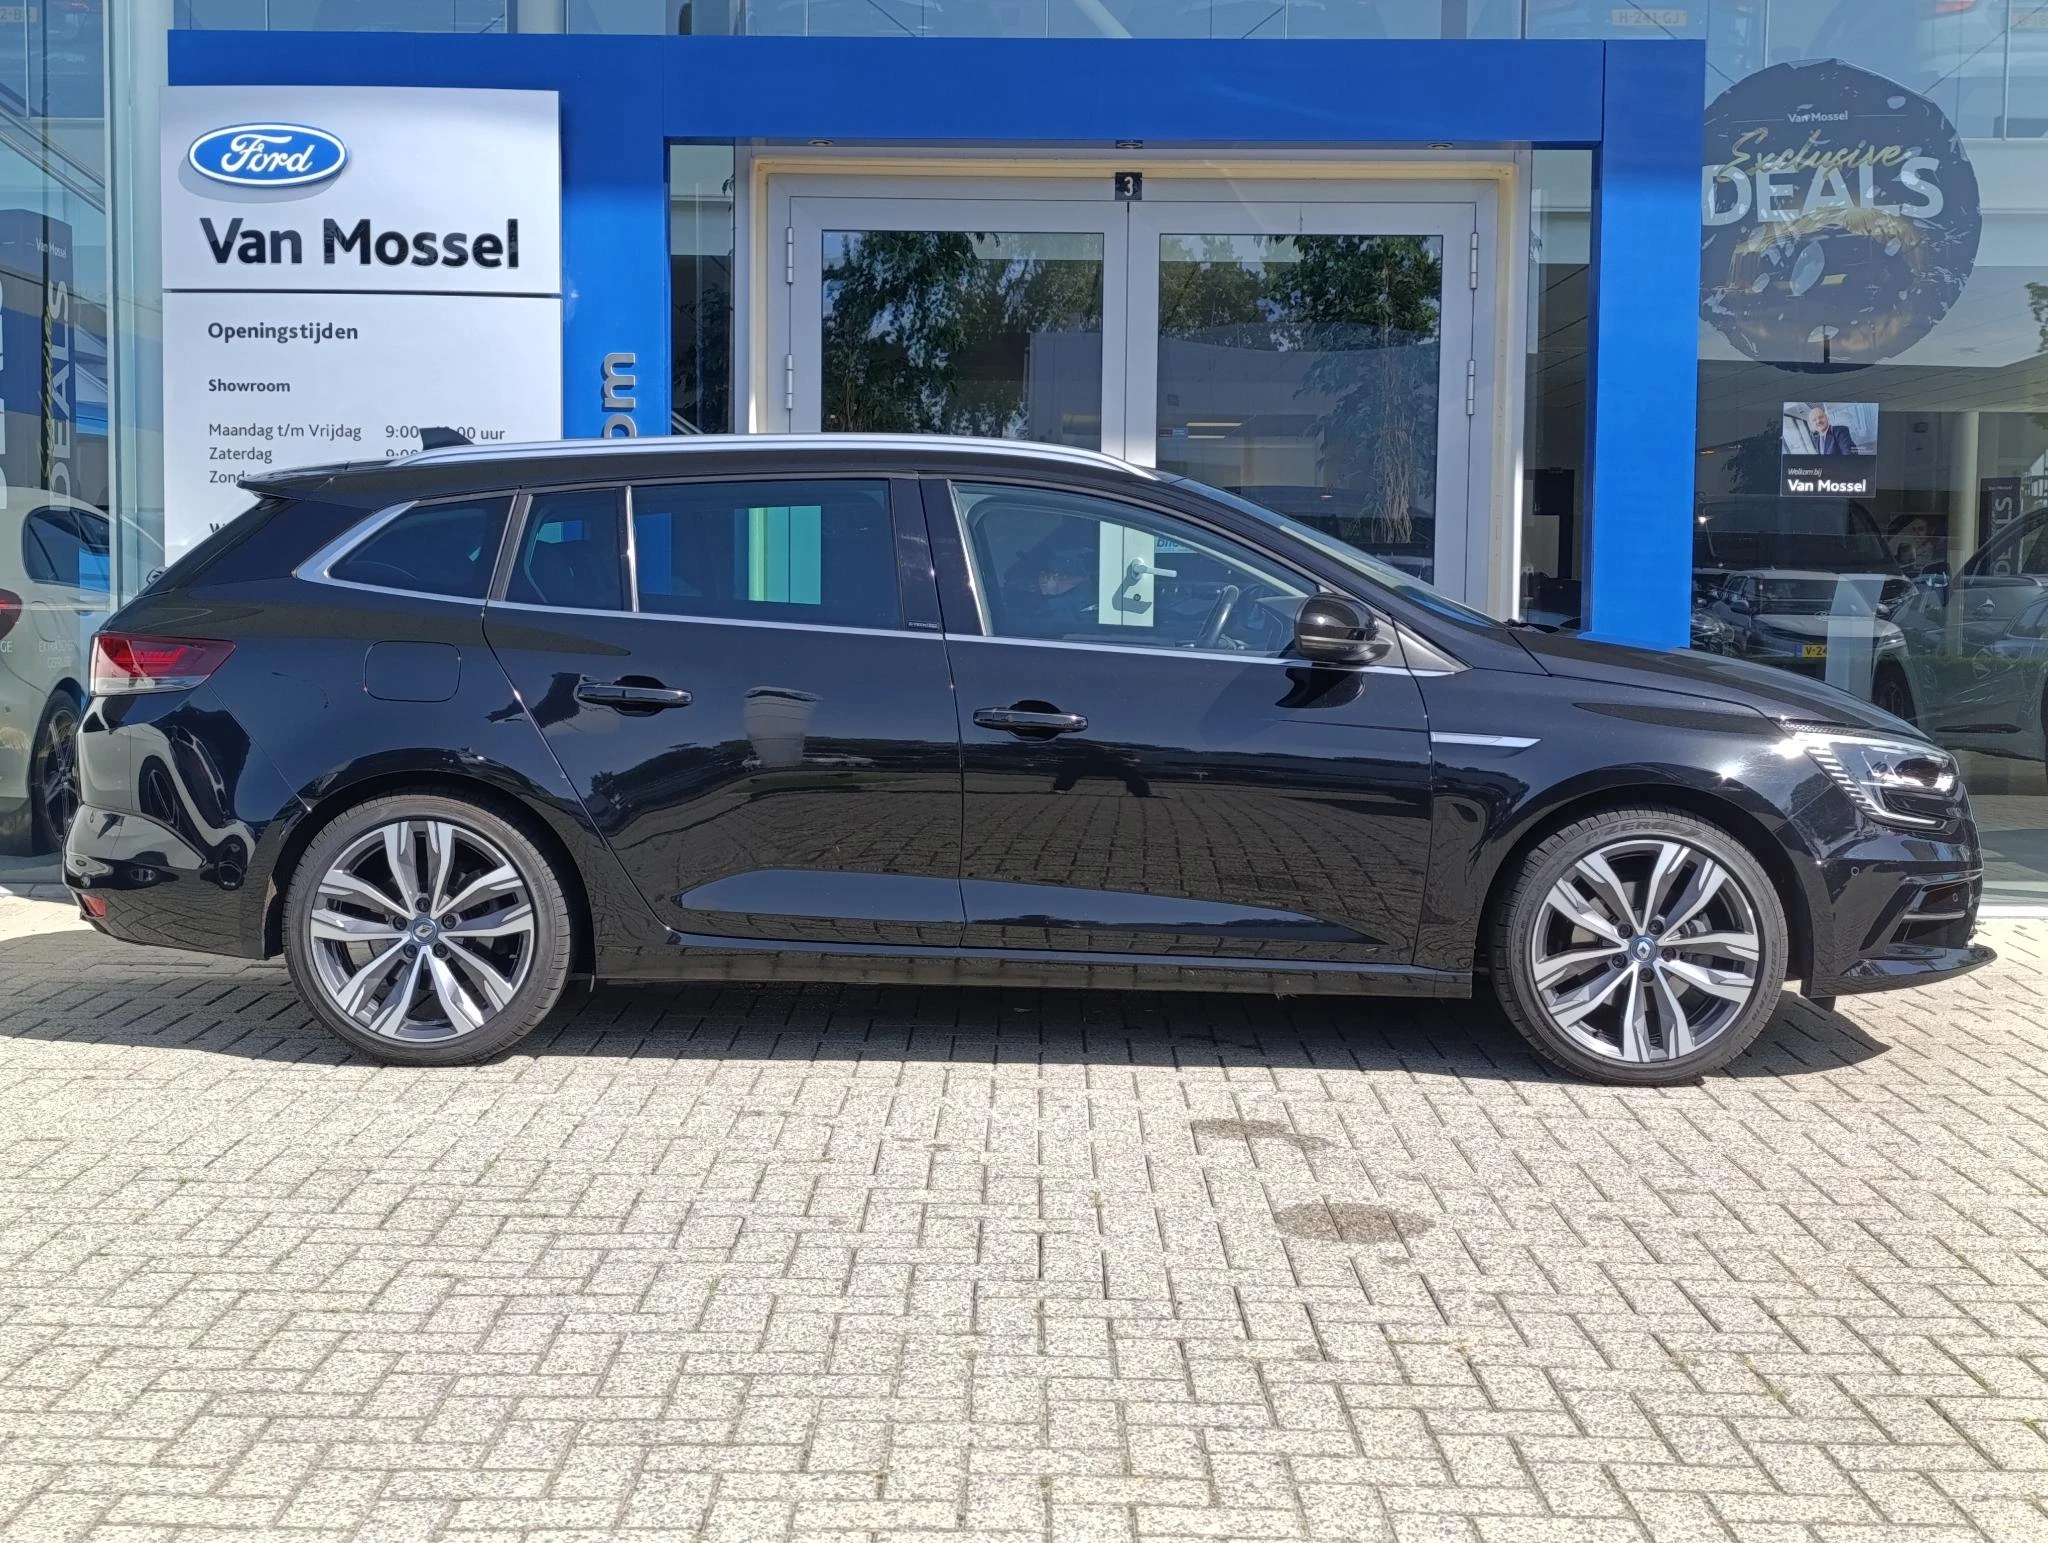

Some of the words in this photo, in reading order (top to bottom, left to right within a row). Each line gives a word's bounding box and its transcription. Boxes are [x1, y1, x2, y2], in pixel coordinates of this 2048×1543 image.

[1787, 113, 1811, 123] Van
[1812, 110, 1849, 122] Mossel
[220, 133, 316, 173] Ford
[1717, 128, 1914, 182] Exclusive
[1124, 176, 1134, 197] 3
[1702, 157, 1944, 226] DEALS
[199, 217, 303, 264] Van
[323, 217, 519, 268] Mossel
[208, 322, 358, 344] Openingstijden
[208, 378, 291, 392] Showroom
[49, 281, 71, 511] DEALS
[209, 423, 274, 441] Maandag
[277, 423, 304, 437] t/m
[309, 424, 362, 442] Vrijdag
[385, 425, 419, 439] 9:00
[480, 430, 505, 440] uur
[209, 447, 273, 464] Zaterdag
[209, 470, 246, 484] Zond
[1787, 479, 1814, 492] Van
[1817, 479, 1867, 492] Mossel
